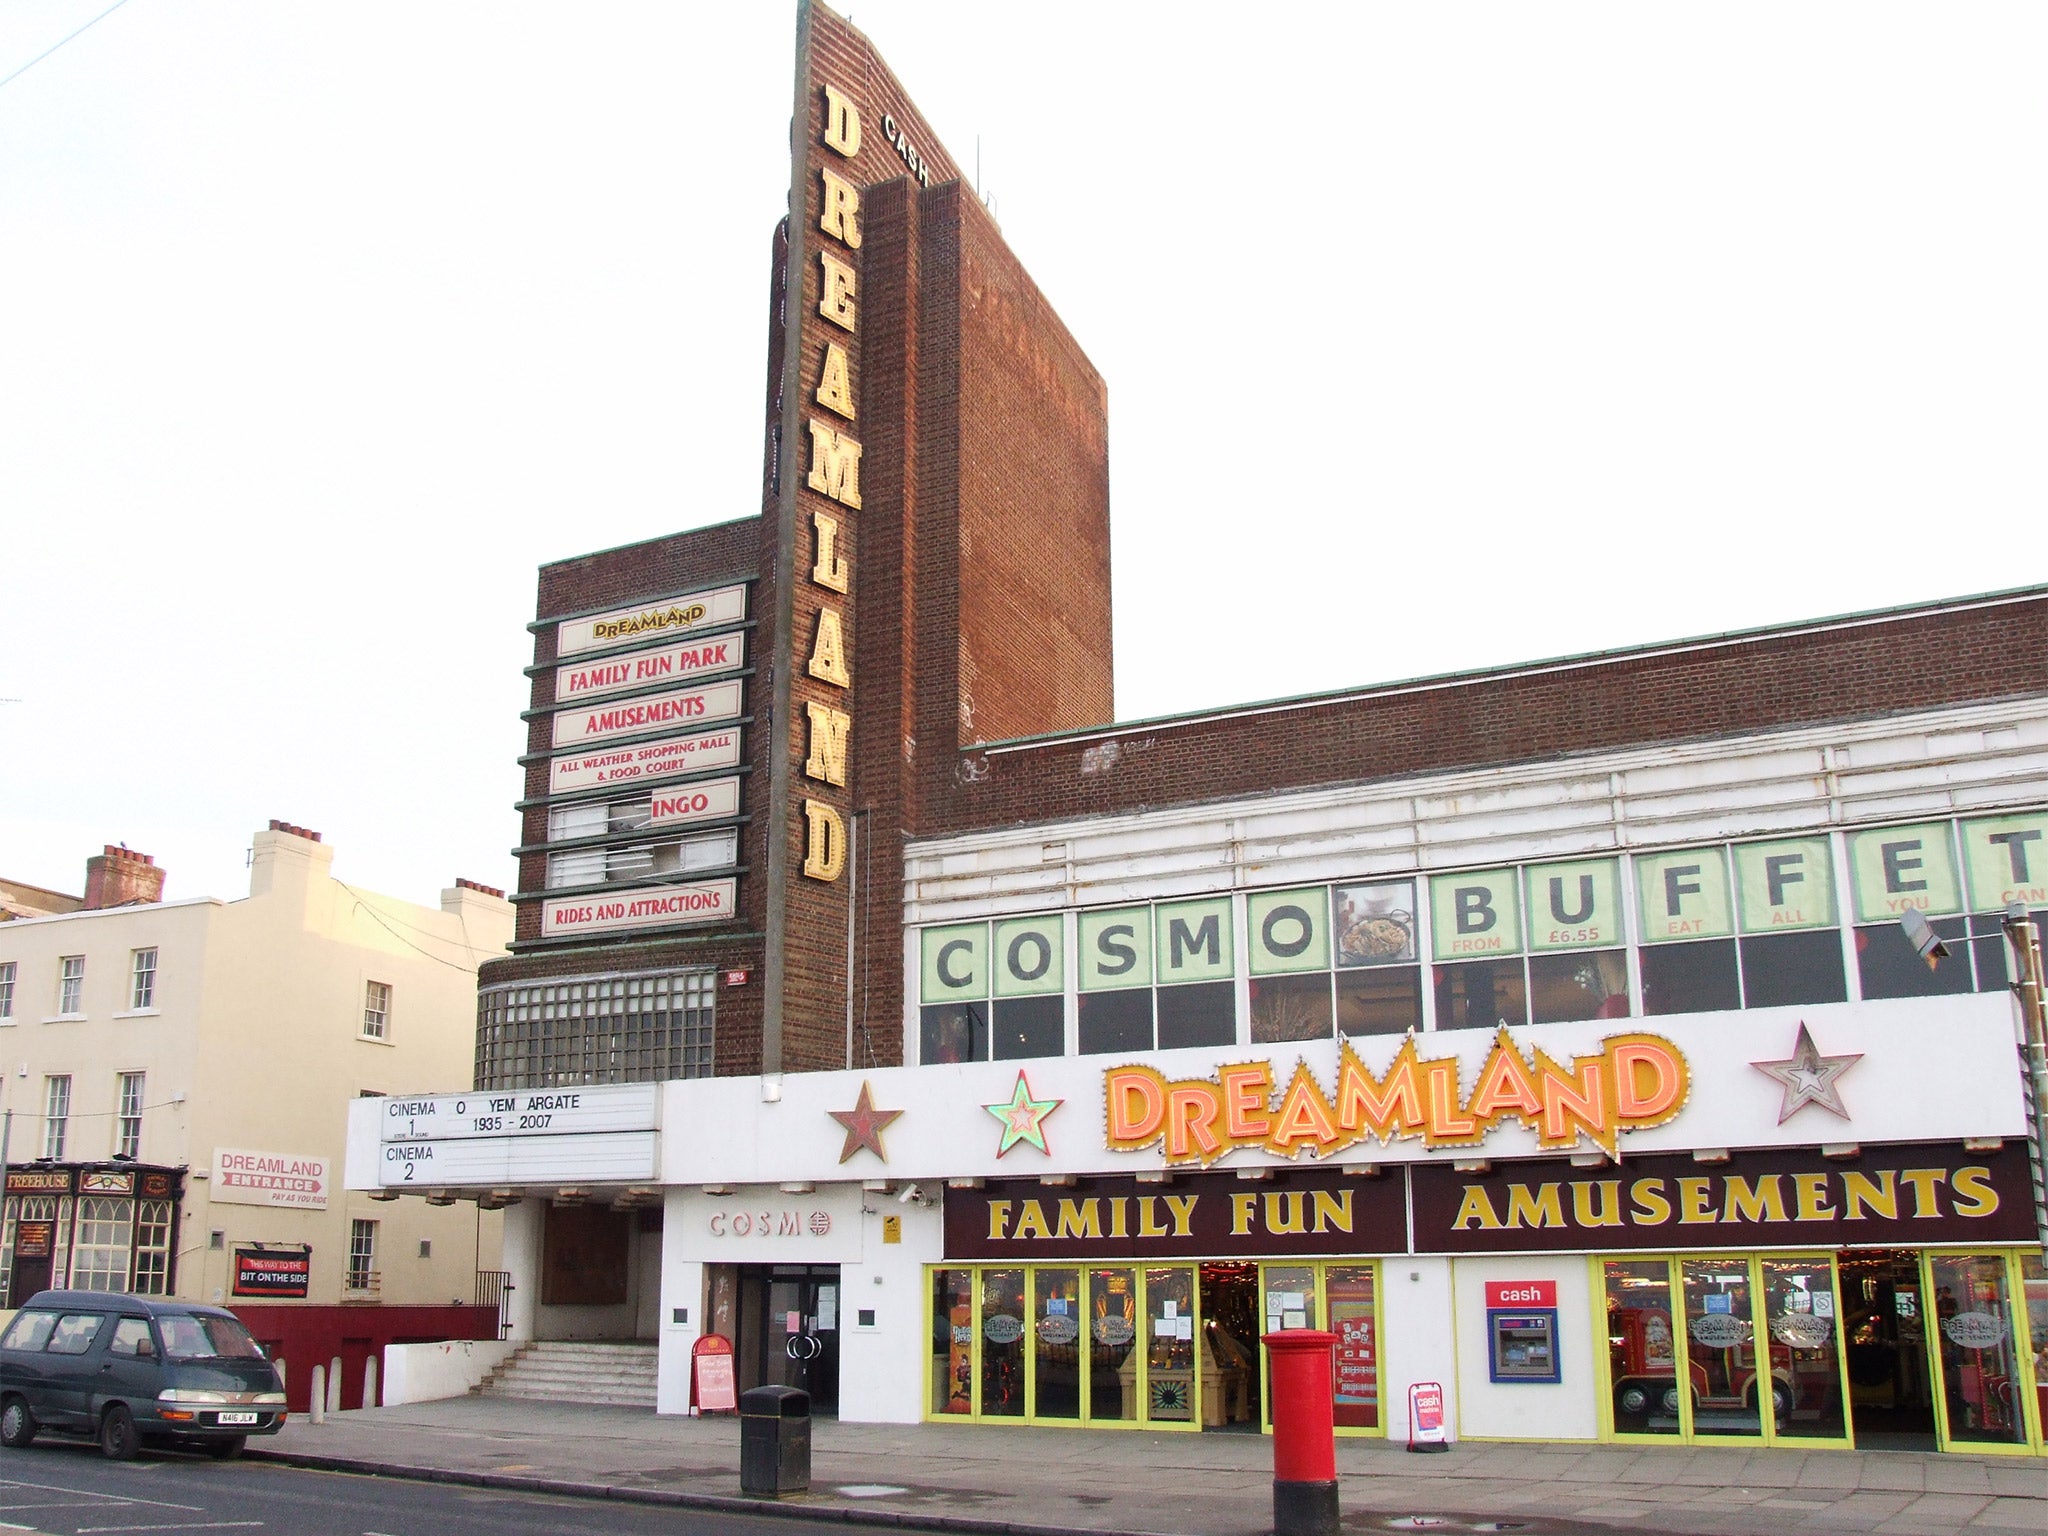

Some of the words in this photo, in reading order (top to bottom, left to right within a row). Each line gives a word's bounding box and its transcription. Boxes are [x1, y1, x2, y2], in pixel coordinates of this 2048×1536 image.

[882, 113, 928, 187] CASH
[804, 83, 862, 882] DREAMLAND
[593, 604, 706, 640] DREAMLAND
[569, 663, 631, 691] FAMILY
[636, 655, 672, 680] FUN
[680, 643, 728, 670] PARK
[585, 695, 705, 734] AMUSEMENTS
[560, 761, 580, 773] ALL
[583, 752, 633, 769] WEATHER
[638, 742, 695, 761] SHOPPING
[700, 736, 731, 751] MALL
[597, 771, 606, 781] &
[610, 766, 641, 780] FOOD
[646, 758, 685, 773] COURT
[652, 793, 709, 818] INGO
[555, 906, 593, 925] RIDES
[596, 903, 625, 920] AND
[628, 892, 721, 917] ATTRACTIONS
[936, 904, 1314, 989] COSMO
[1454, 829, 2042, 935] BUFFET
[1452, 937, 1501, 952] FROM
[1549, 927, 1600, 944] £6.55
[1667, 919, 1703, 935] EAT
[1771, 909, 1806, 925] ALL
[1887, 896, 1930, 912] YOU
[2001, 887, 2046, 905] CAN
[389, 1102, 436, 1117] CINEMA
[489, 1098, 515, 1112] YEM
[527, 1094, 580, 1110] ARGATE
[1106, 1036, 1686, 1160] DREAMLAND
[409, 1119, 415, 1136] 1
[473, 1117, 502, 1131] 1935
[520, 1114, 552, 1128] 2007
[221, 1153, 323, 1177] DREAMLAND
[386, 1146, 433, 1161] CINEMA
[7, 1174, 69, 1188] FREEHOUSE
[231, 1173, 313, 1191] ENTRANCE
[404, 1162, 414, 1180] 2
[272, 1192, 285, 1200] PAY
[286, 1193, 295, 1202] AS
[297, 1194, 311, 1203] YOU
[312, 1196, 327, 1204] RIDE
[1451, 1166, 2000, 1231] AMUSEMENTS
[987, 1194, 1199, 1240] FAMILY
[1230, 1189, 1354, 1235] FUN
[264, 1261, 279, 1269] WAY
[240, 1272, 256, 1281] BIT
[257, 1272, 271, 1282] ON
[272, 1273, 288, 1282] THE
[290, 1274, 307, 1283] SIDE
[1500, 1286, 1541, 1302] cash
[1417, 1395, 1439, 1407] cash
